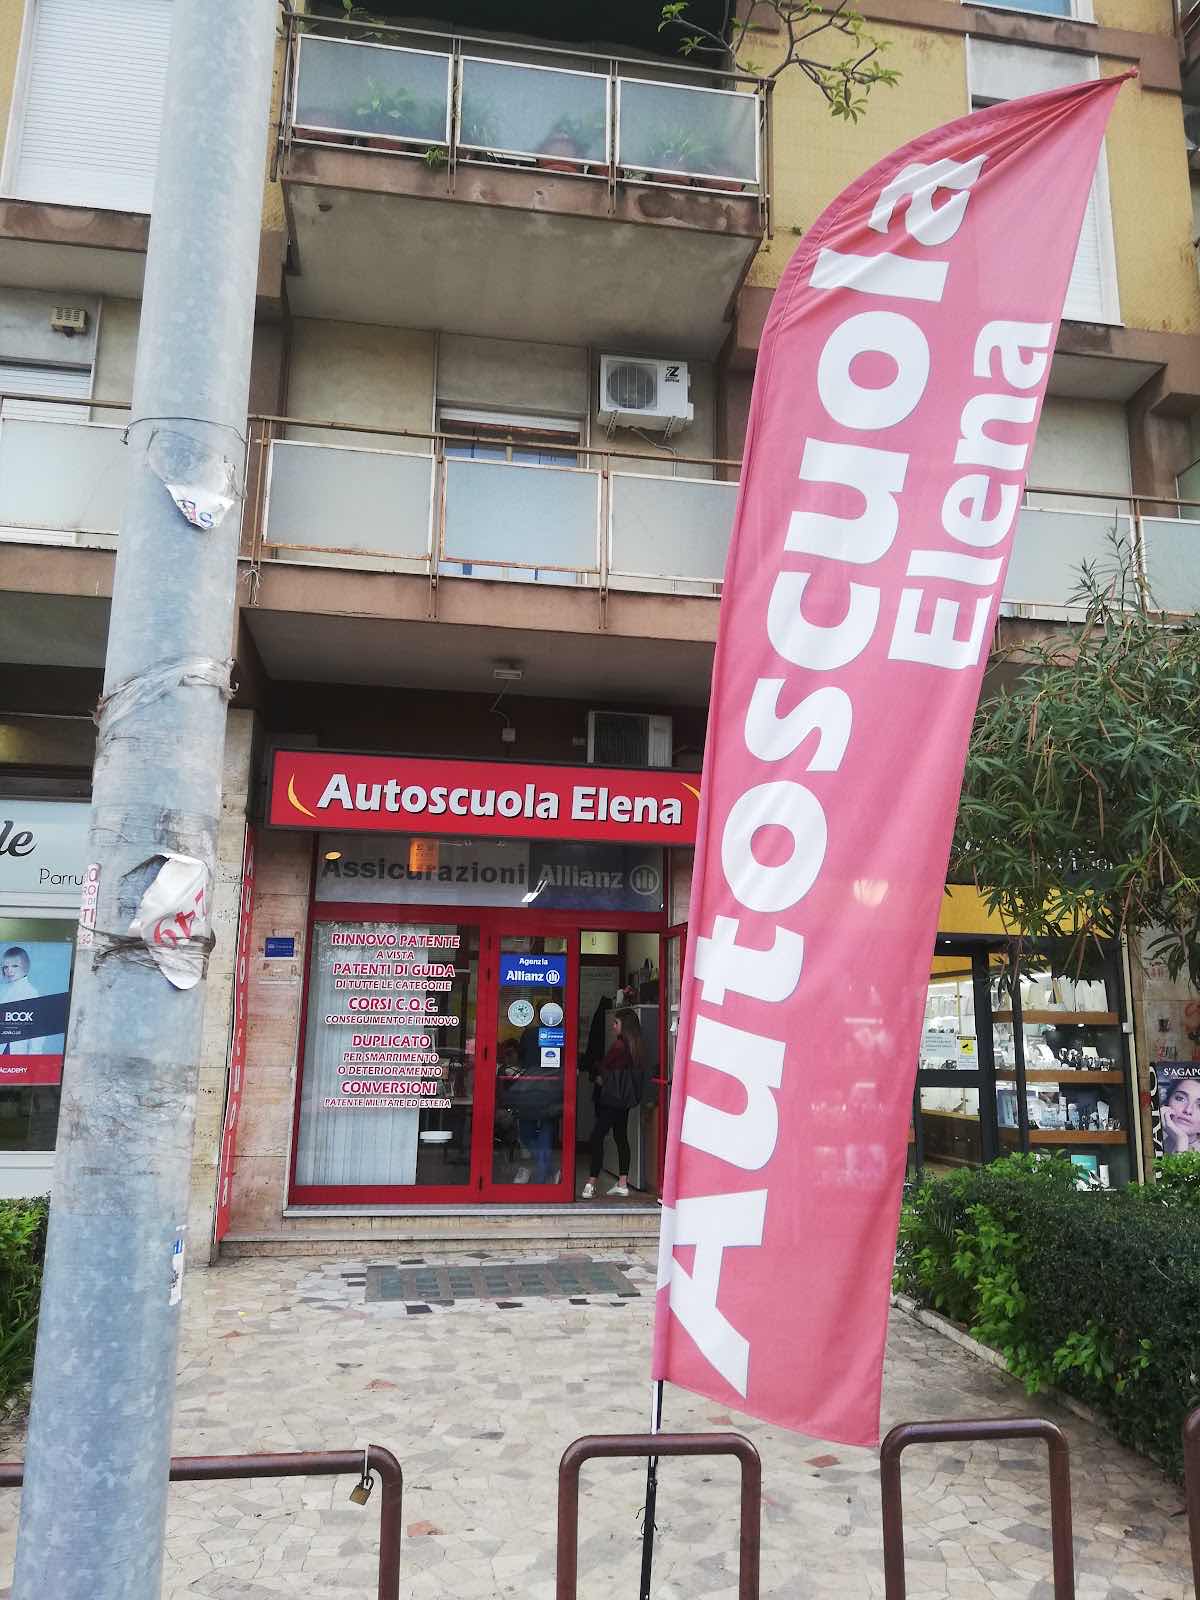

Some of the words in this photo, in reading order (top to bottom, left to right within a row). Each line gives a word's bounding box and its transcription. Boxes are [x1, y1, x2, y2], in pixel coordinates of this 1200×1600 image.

[888, 319, 1053, 669] Elena
[659, 154, 988, 1397] Autoscuola
[316, 773, 560, 819] Autoscuola
[570, 785, 683, 825] Elena
[321, 857, 525, 885] Assicurazioni
[537, 863, 624, 889] Allianz
[331, 933, 397, 946] RINNOVO
[400, 934, 460, 948] PATENTE
[376, 950, 384, 960] A
[386, 950, 415, 961] VISTA
[519, 958, 548, 966] Agenzia
[333, 963, 391, 976] PATENTI
[394, 964, 408, 976] DI
[411, 964, 456, 977] GUIDA
[506, 970, 545, 981] Allianz
[335, 979, 346, 990] DI
[348, 979, 379, 990] TUTTE
[381, 980, 393, 990] LE
[395, 980, 452, 991] CATEGORIE
[348, 997, 392, 1011] CORSI
[395, 997, 439, 1012] C.Q.C.
[5, 1011, 34, 1021] BOOK
[325, 1015, 405, 1025] CONSEGUIMENTO
[407, 1016, 414, 1025] E
[415, 1016, 460, 1026] RINNOVO
[352, 1034, 431, 1048] DUPLICATO
[343, 1053, 362, 1062] PER
[363, 1053, 440, 1063] SMARRIMENTO
[337, 1065, 346, 1075] O
[348, 1066, 442, 1077] DETERIORAMENTO
[341, 1081, 438, 1095] CONVERSIONI
[324, 1098, 363, 1108] PATENTE
[406, 1099, 418, 1108] ED
[420, 1099, 452, 1109] ESTERA
